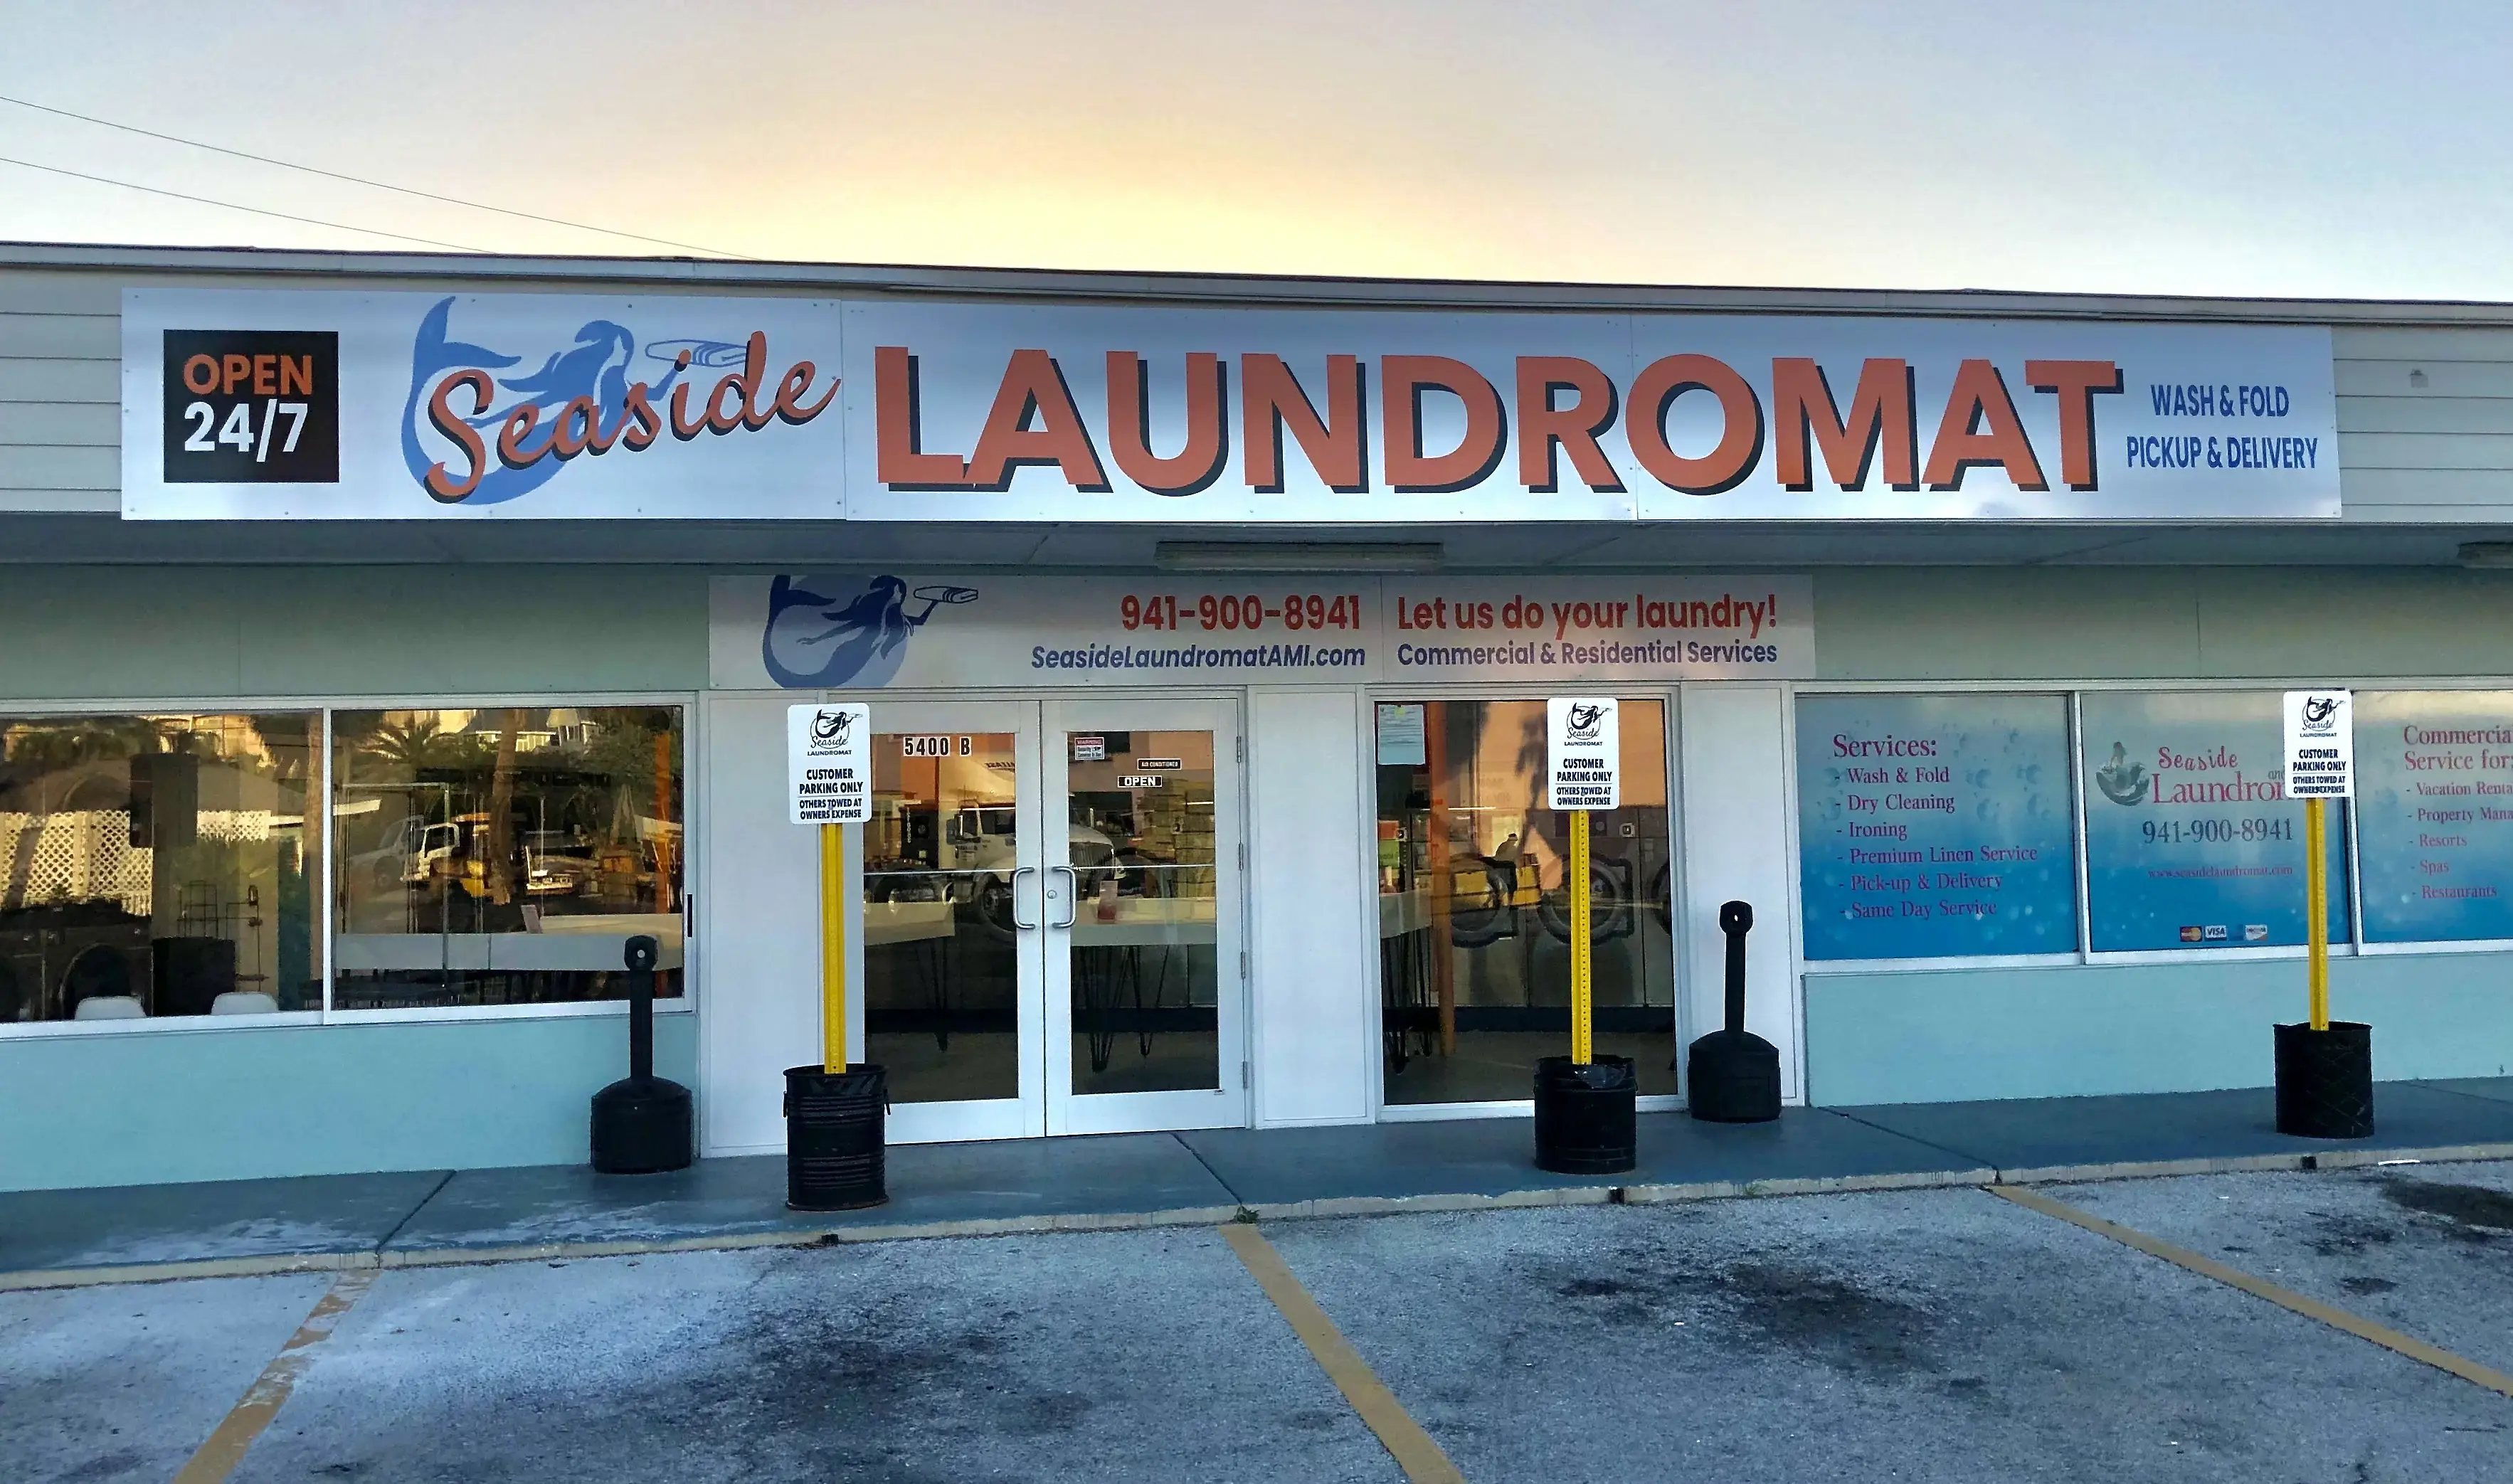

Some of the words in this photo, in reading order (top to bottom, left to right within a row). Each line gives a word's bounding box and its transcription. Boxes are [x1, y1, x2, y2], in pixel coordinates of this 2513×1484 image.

[184, 354, 312, 395] OPEN
[2150, 384, 2214, 416] WASH
[2219, 385, 2235, 417] &
[2239, 385, 2290, 417] FOLD
[423, 330, 841, 504] Seaside
[874, 346, 2123, 496] LAUNDROMAT
[184, 398, 308, 462] 24/7
[2127, 435, 2202, 468] PICKUP
[2207, 436, 2223, 468] &
[2227, 437, 2317, 469] DELIVERY
[1121, 595, 1360, 631] 941-900-8941
[1397, 596, 1446, 630] Let
[1456, 601, 1493, 630] us
[1502, 595, 1545, 630] do
[1554, 600, 1629, 640] your
[1636, 594, 1777, 640] laundry!
[1031, 642, 1365, 669] SeasideLaundromatAMI.com
[1397, 640, 1535, 666] Commercial
[1540, 642, 1556, 664] &
[1561, 640, 1681, 664] Residential
[1687, 639, 1777, 663] Services
[1567, 726, 1598, 738] Seaside
[2302, 719, 2333, 731] Seaside
[810, 736, 847, 748] Seaside
[2403, 725, 2513, 745] Commercia
[904, 737, 949, 756] 5400
[961, 737, 970, 756] B
[1833, 733, 1937, 758] Services:
[2299, 748, 2339, 759] CUSTOMER
[1562, 758, 1604, 769] CUSTOMER
[2158, 746, 2238, 771] Seaside
[2292, 761, 2326, 771] PARKING
[2327, 760, 2347, 770] ONLY
[2405, 750, 2473, 770] Service
[806, 768, 854, 780] CUSTOMER
[1124, 776, 1156, 786] OPEN
[1557, 771, 1590, 782] PARKING
[1592, 771, 1612, 782] ONLY
[1846, 767, 1889, 784] Wash
[1895, 767, 1908, 783] &
[1915, 766, 1950, 783] Fold
[799, 783, 838, 795] PARKING
[840, 782, 864, 793] ONLY
[1556, 786, 1580, 795] OTHERS
[1580, 786, 1602, 795] TOWED
[1603, 786, 1612, 795] AT
[2152, 770, 2286, 804] Laundro
[2416, 782, 2471, 796] Vacation
[799, 799, 826, 809] OTHERS
[827, 798, 852, 807] TOWED
[853, 798, 862, 807] AT
[1557, 797, 1583, 805] OWNERS
[1584, 797, 1611, 805] EXPENSE
[1848, 795, 1878, 815] Dry
[1885, 793, 1955, 814] Cleaning
[800, 810, 830, 820] OWNERS
[831, 810, 862, 819] EXPENSE
[2418, 807, 2473, 825] Property
[1849, 821, 1908, 841] Ironing
[2142, 818, 2292, 844] 941-900-8941
[2419, 833, 2467, 847] Resorts
[1850, 847, 1923, 864] Premium
[1930, 846, 1974, 863] Linen
[1980, 844, 2038, 862] Service
[2420, 859, 2450, 875] Spas
[1851, 874, 1911, 893] Pick-up
[1917, 874, 1930, 890] &
[1937, 872, 2004, 891] Delivery
[2421, 885, 2497, 899] Restaurants
[1851, 902, 1895, 918] Same
[1901, 901, 1931, 921] Day
[1940, 899, 1997, 916] Service
[2207, 927, 2225, 936] VISA
